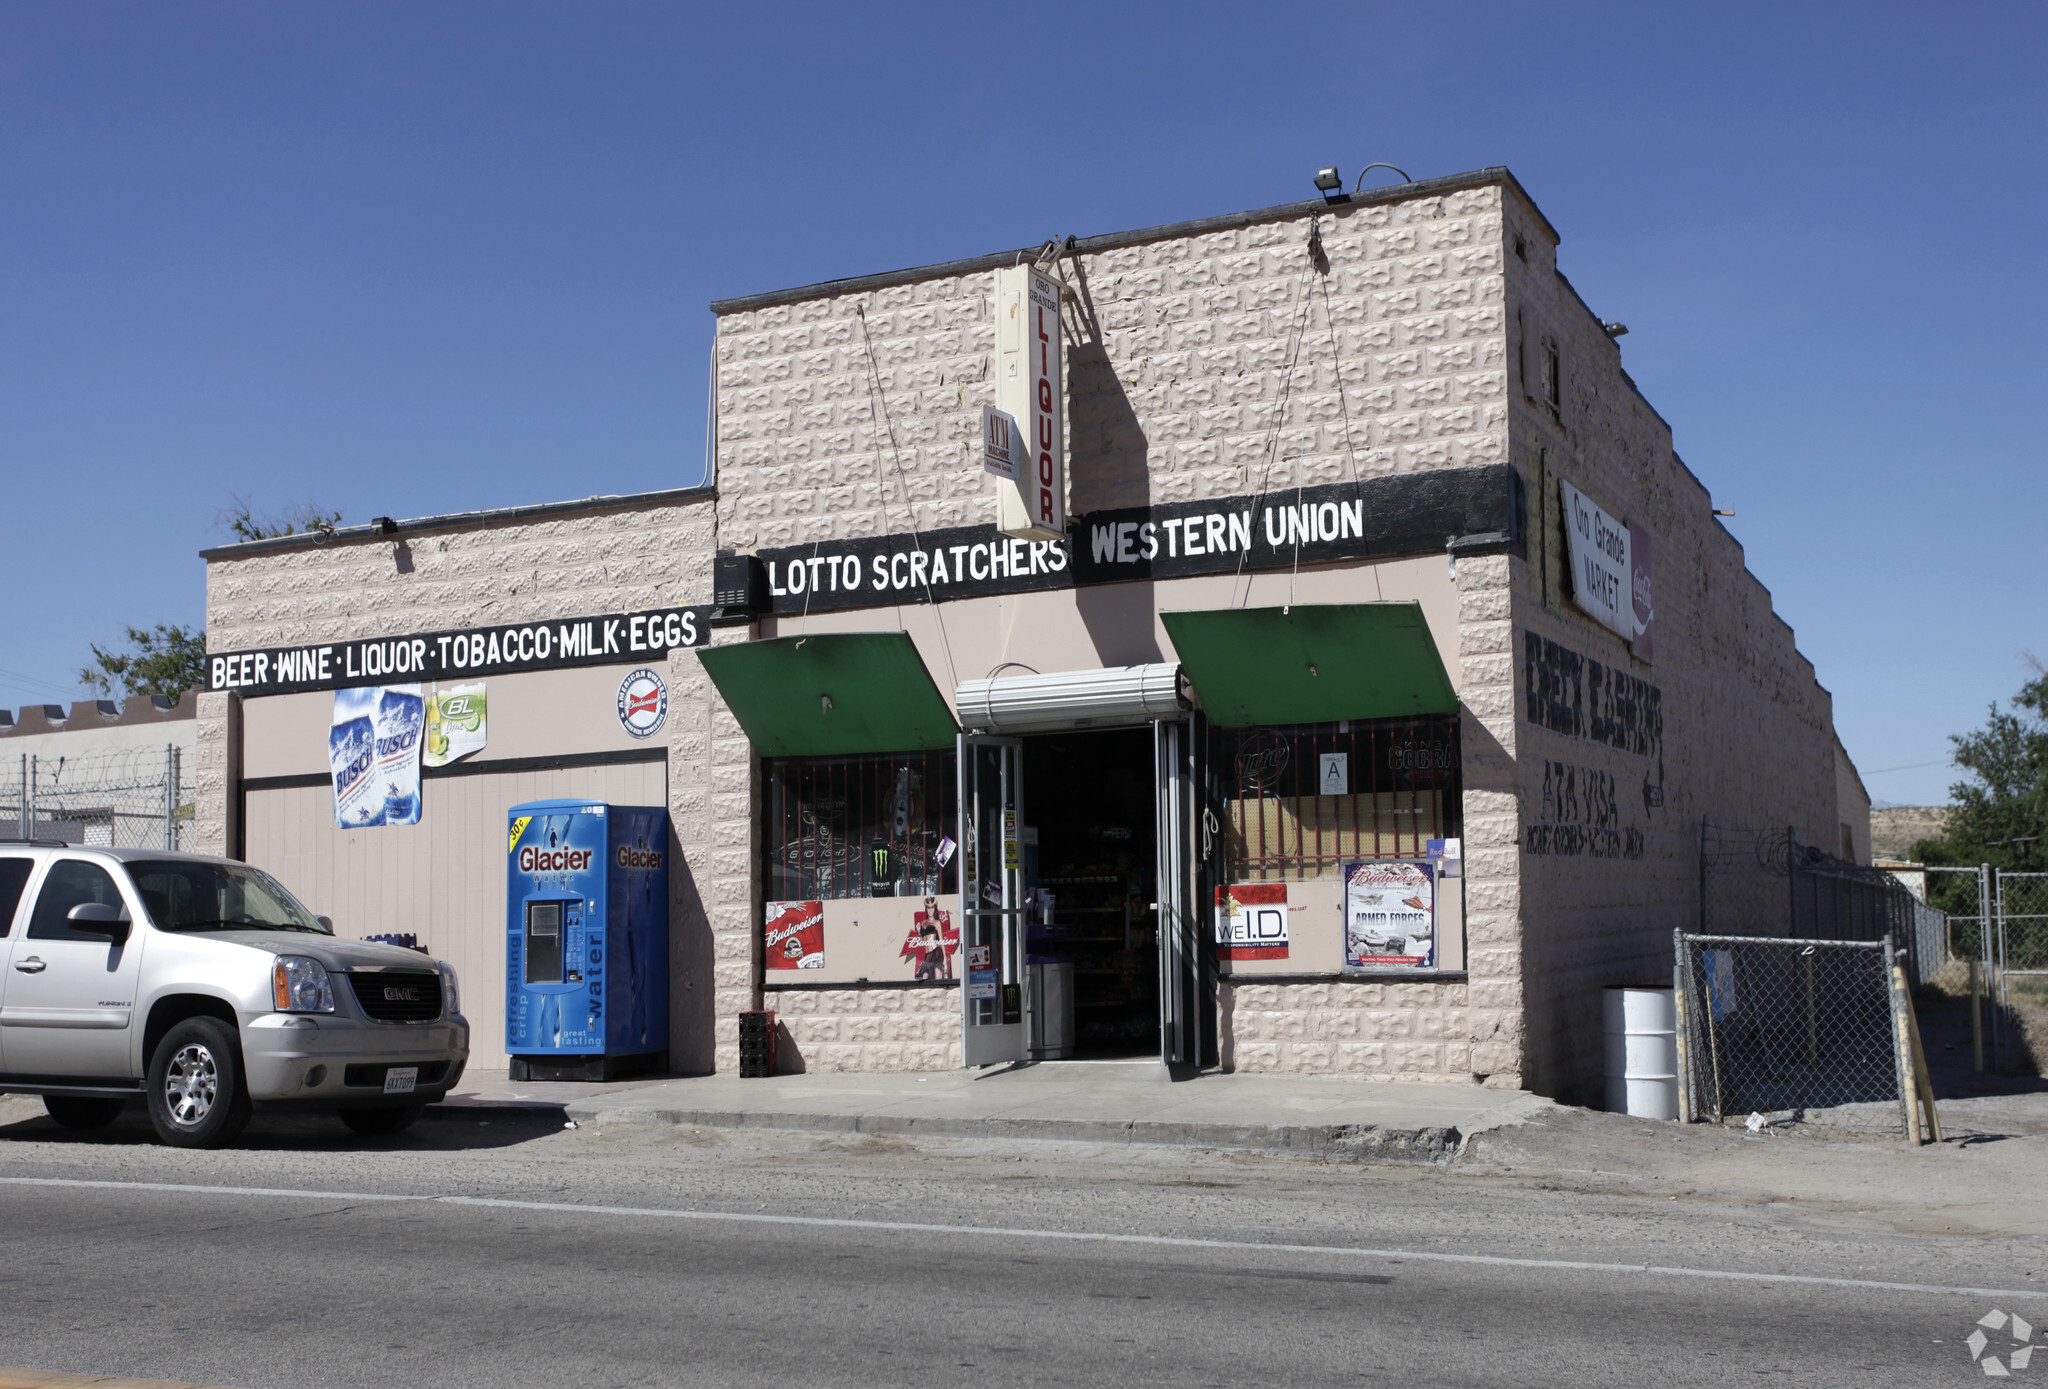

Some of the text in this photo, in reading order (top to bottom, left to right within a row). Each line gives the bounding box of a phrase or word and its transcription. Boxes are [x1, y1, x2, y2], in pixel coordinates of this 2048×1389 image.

[1029, 289, 1057, 312] GRANDE
[1035, 278, 1050, 294] ORO
[1037, 305, 1054, 524] LIQUOR
[988, 413, 1009, 450] ATM
[1091, 499, 1363, 564] WESTERN UNION
[1574, 492, 1625, 567] Oro Grande
[769, 538, 1068, 596] LOTTO SCRATCHERS
[1583, 553, 1619, 614] MARKET
[212, 610, 697, 689] BEER WINE LIQUOR TOBACCO MILK EGGS
[618, 670, 667, 708] AMERICAN OWNED
[1525, 628, 1664, 759] CHECK CASHING
[447, 698, 474, 715] BL
[376, 726, 419, 757] BUSCH
[1388, 744, 1459, 770] COBRA
[1404, 740, 1442, 749] KING
[336, 744, 373, 797] BUSCH
[1327, 761, 1340, 779] A
[1541, 759, 1618, 829] ATM VISA
[520, 846, 592, 872] Glacier
[617, 846, 662, 869] Glacier
[1429, 847, 1456, 856] Red Bull
[1352, 870, 1427, 885] Budweiser
[765, 912, 823, 948] Budweiser
[1217, 909, 1287, 940] WE I.D.
[1355, 912, 1425, 926] ARMED FORCES
[906, 936, 959, 949] Budweiser
[508, 936, 522, 1045] refreshing
[587, 936, 602, 1019] water
[384, 987, 420, 1001] GMC
[518, 995, 528, 1038] crisp
[561, 1037, 602, 1047] tasting
[563, 1030, 586, 1038] great
